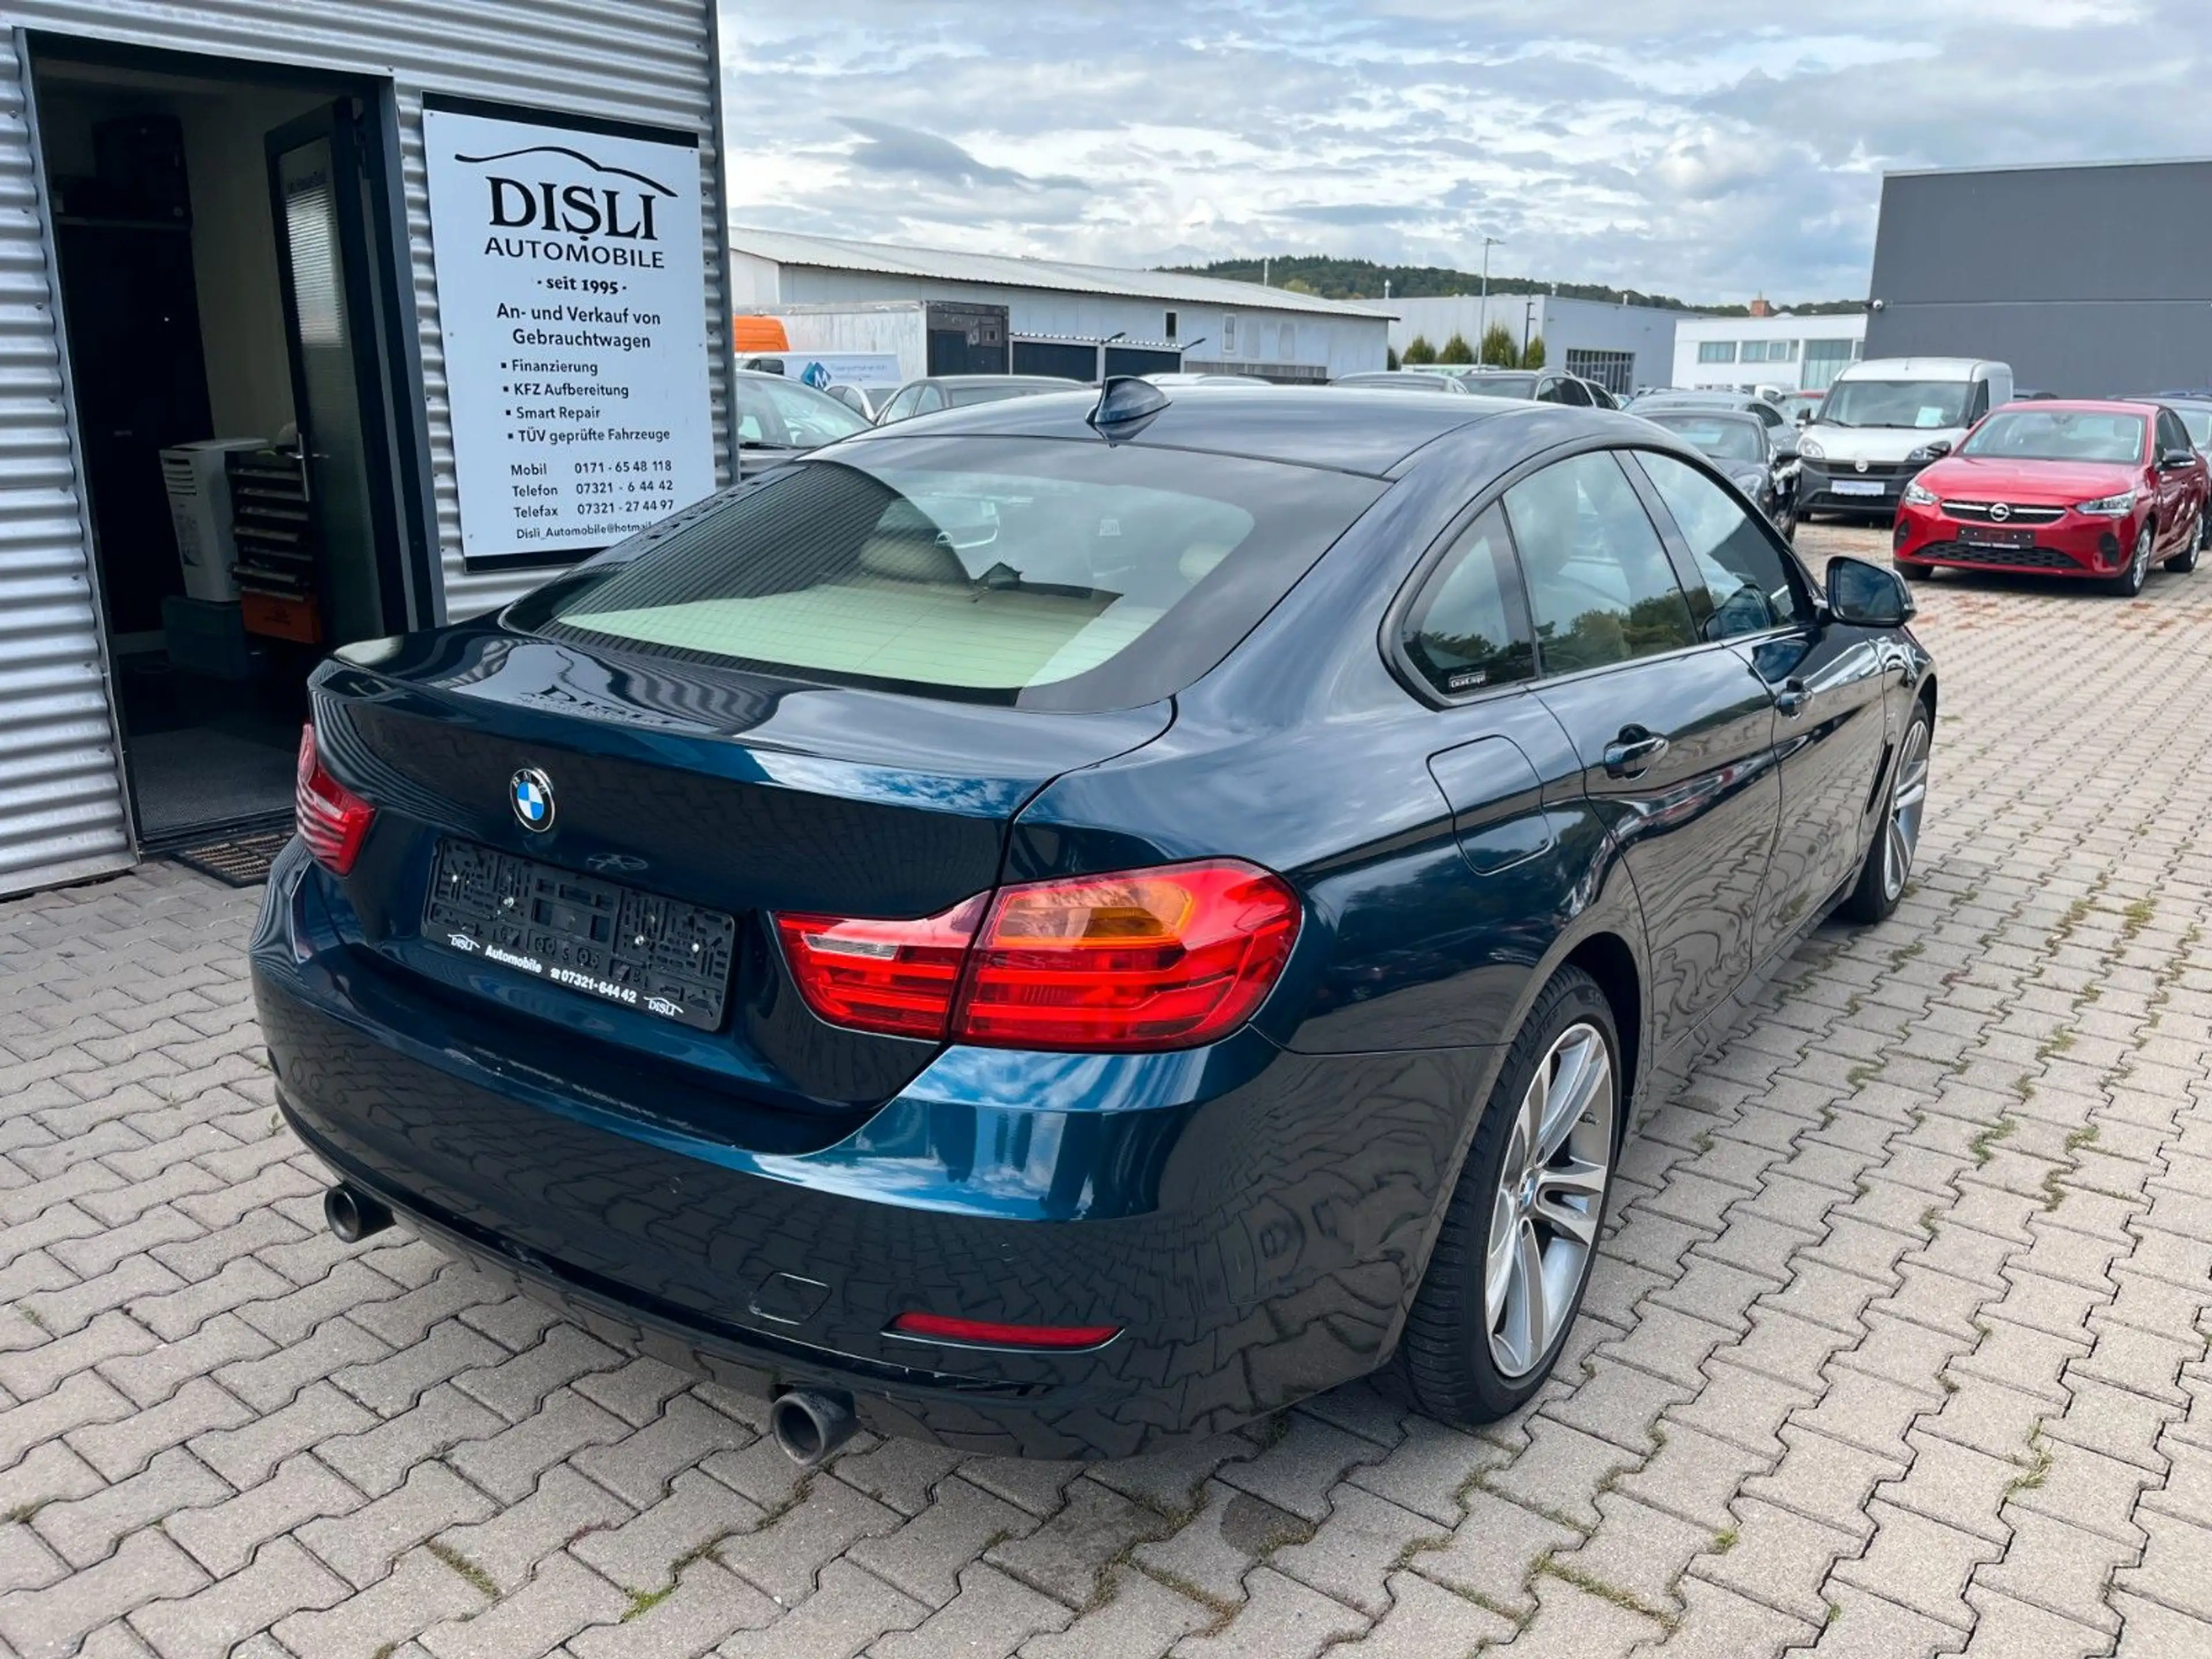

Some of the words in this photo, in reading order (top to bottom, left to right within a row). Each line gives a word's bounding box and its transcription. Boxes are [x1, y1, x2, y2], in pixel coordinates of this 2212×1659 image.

[484, 237, 665, 269] AUTOMOBILE
[546, 276, 577, 290] seit
[581, 279, 619, 294] 1995
[497, 302, 526, 319] An-
[531, 305, 563, 321] und
[567, 306, 629, 324] Verkauf
[633, 313, 661, 325] von
[513, 328, 651, 352] Gebrauchtwagen
[512, 358, 599, 377] Finanzierung
[514, 383, 541, 396] KFZ
[544, 382, 630, 399] Aufbereitung
[516, 406, 556, 419] Smart
[559, 406, 601, 422] Repair
[518, 426, 546, 442] TÜV
[549, 427, 605, 445] geprüfte
[608, 427, 671, 443] Fahrzeuge
[511, 463, 547, 476] Mobil
[574, 462, 604, 474] 0171
[653, 460, 672, 471] 118
[512, 484, 559, 497] Telefon
[576, 482, 613, 495] 07321
[639, 480, 654, 491] 44
[659, 479, 673, 491] 42
[514, 505, 559, 518] Telefax
[577, 502, 615, 515] 07321
[484, 944, 543, 974] Automobile
